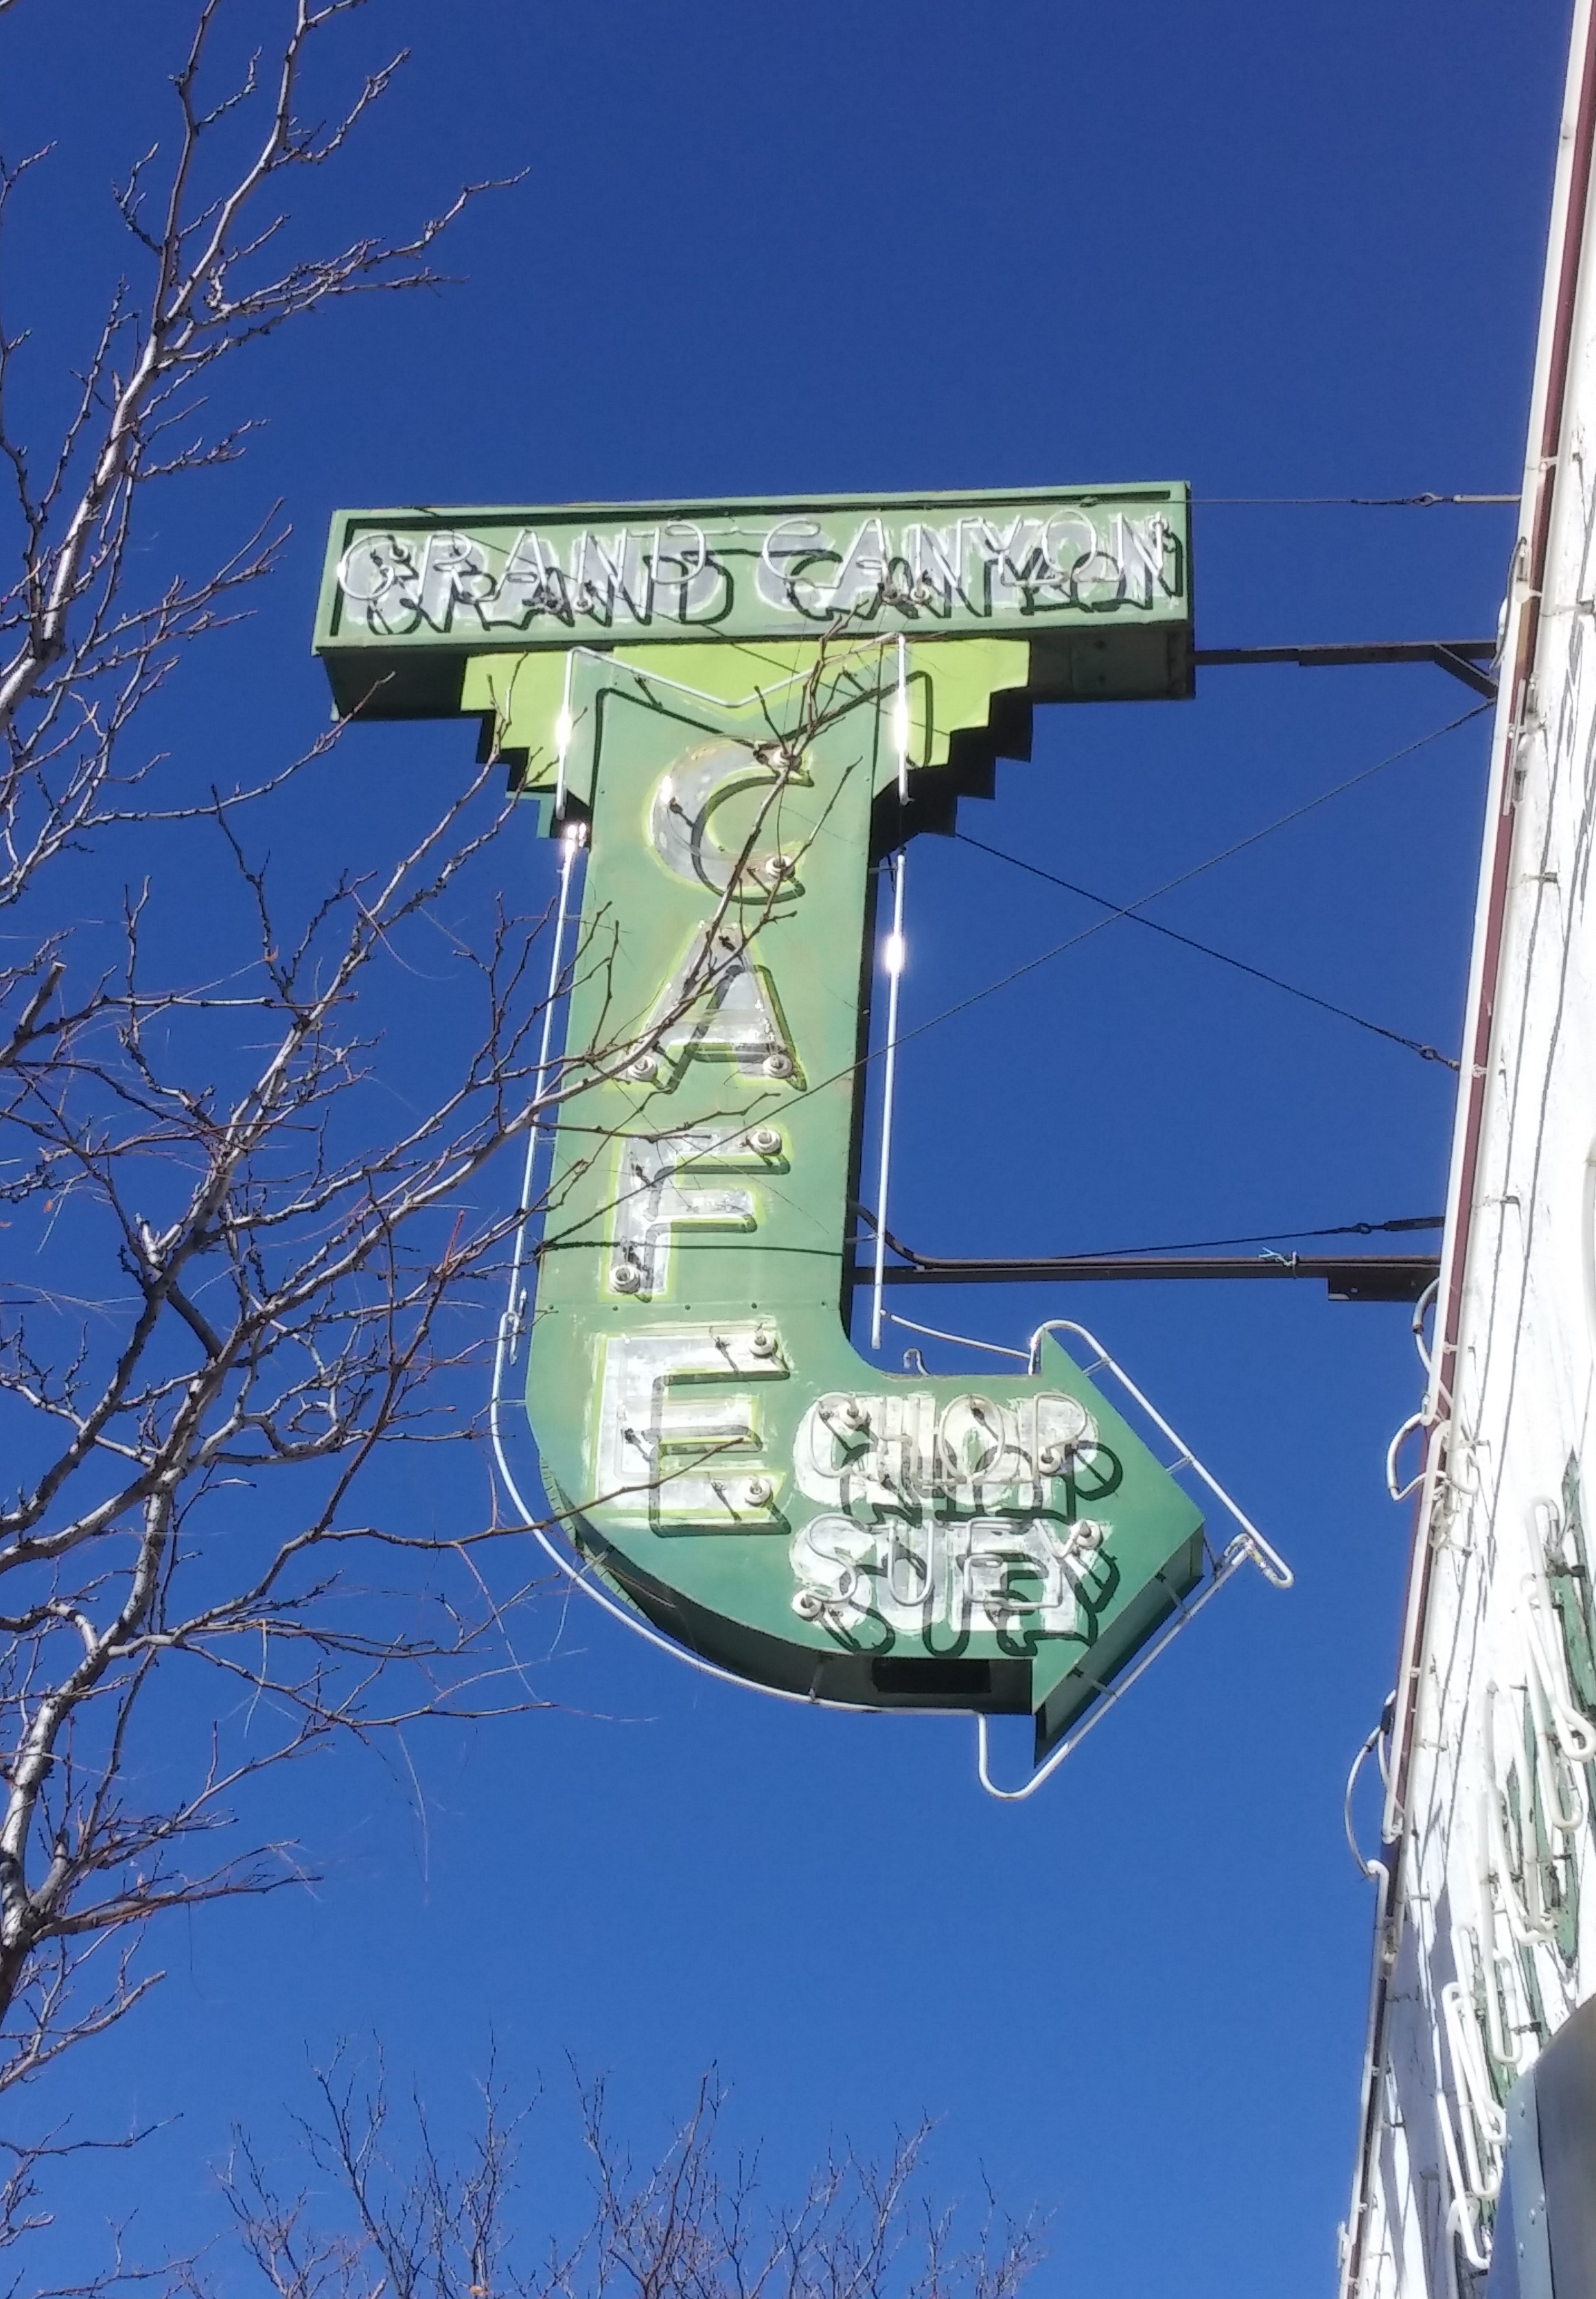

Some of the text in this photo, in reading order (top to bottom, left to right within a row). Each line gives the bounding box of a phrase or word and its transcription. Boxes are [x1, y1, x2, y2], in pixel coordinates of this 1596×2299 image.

[338, 510, 1179, 626] GRAND CANYON
[590, 739, 809, 1525] CAFE
[794, 1391, 1100, 1506] CHOP
[789, 1513, 1109, 1634] SUEY
